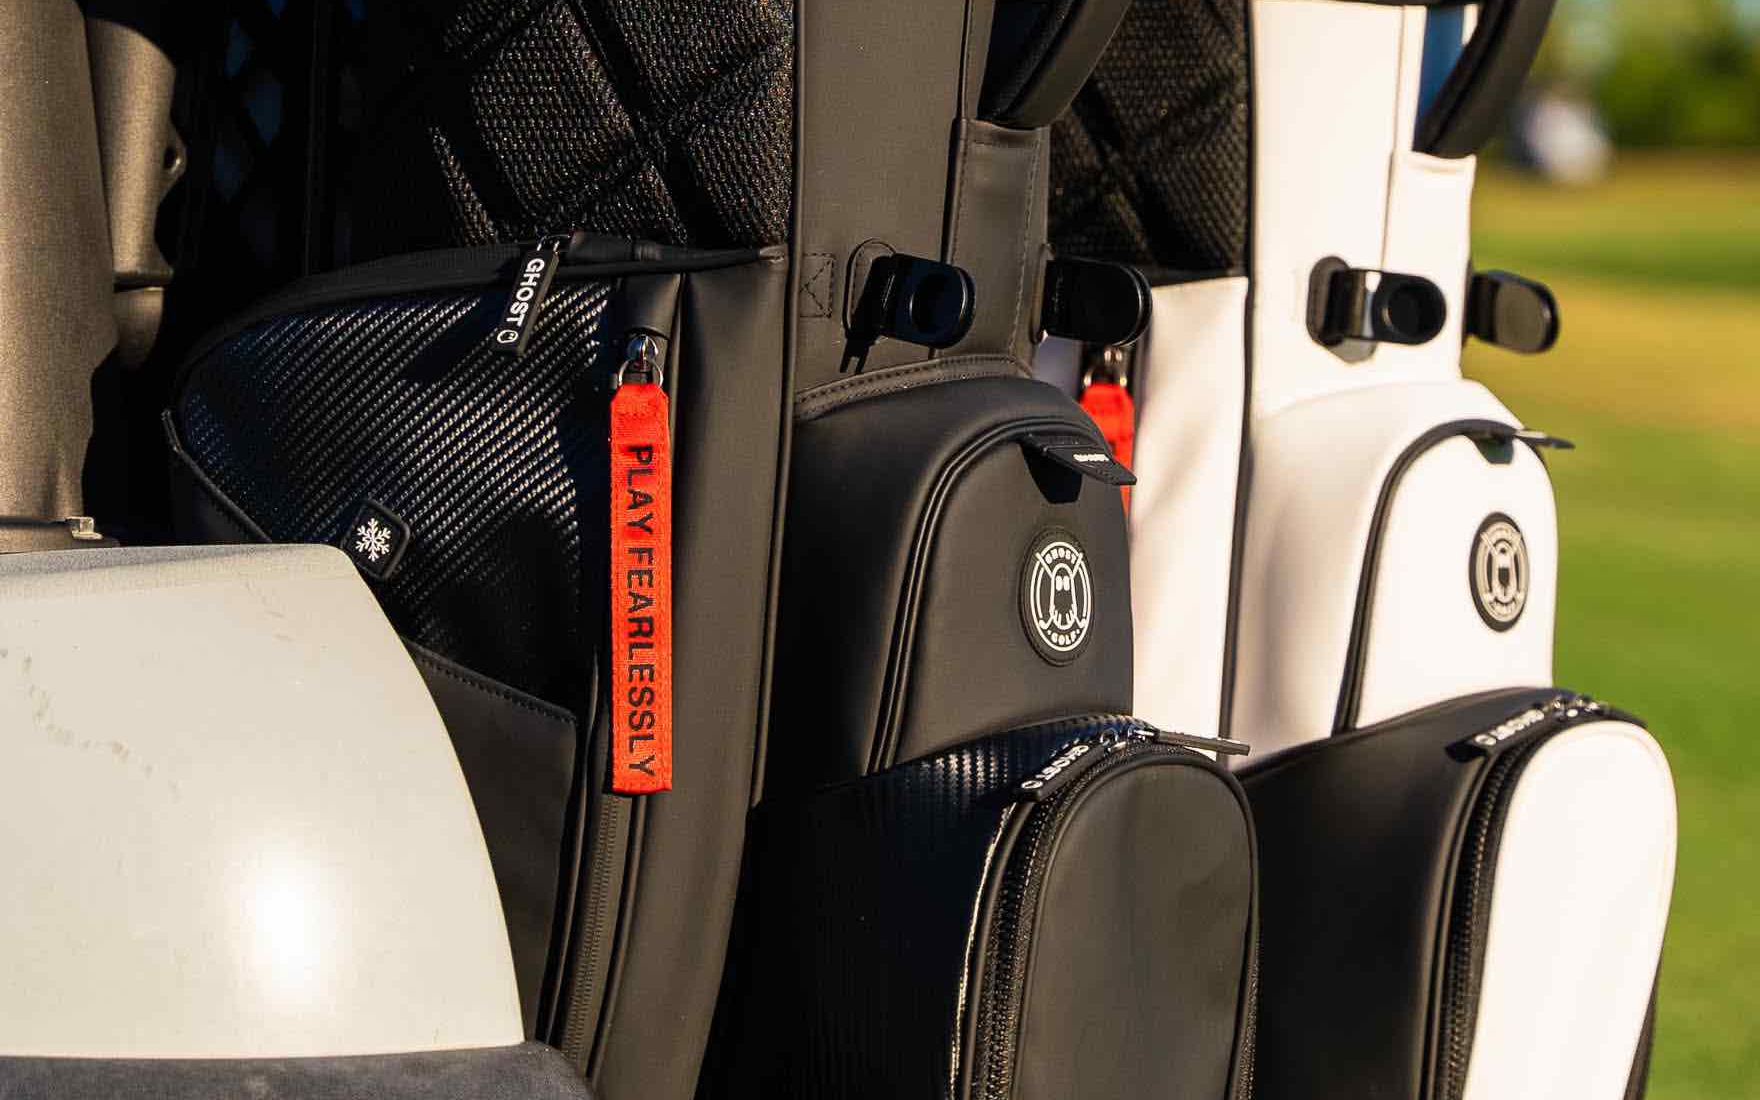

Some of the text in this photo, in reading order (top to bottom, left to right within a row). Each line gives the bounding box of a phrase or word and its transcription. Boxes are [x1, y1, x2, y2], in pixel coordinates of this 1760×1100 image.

[506, 258, 545, 327] GHOST
[626, 445, 656, 776] PLAY FEARLESSLY
